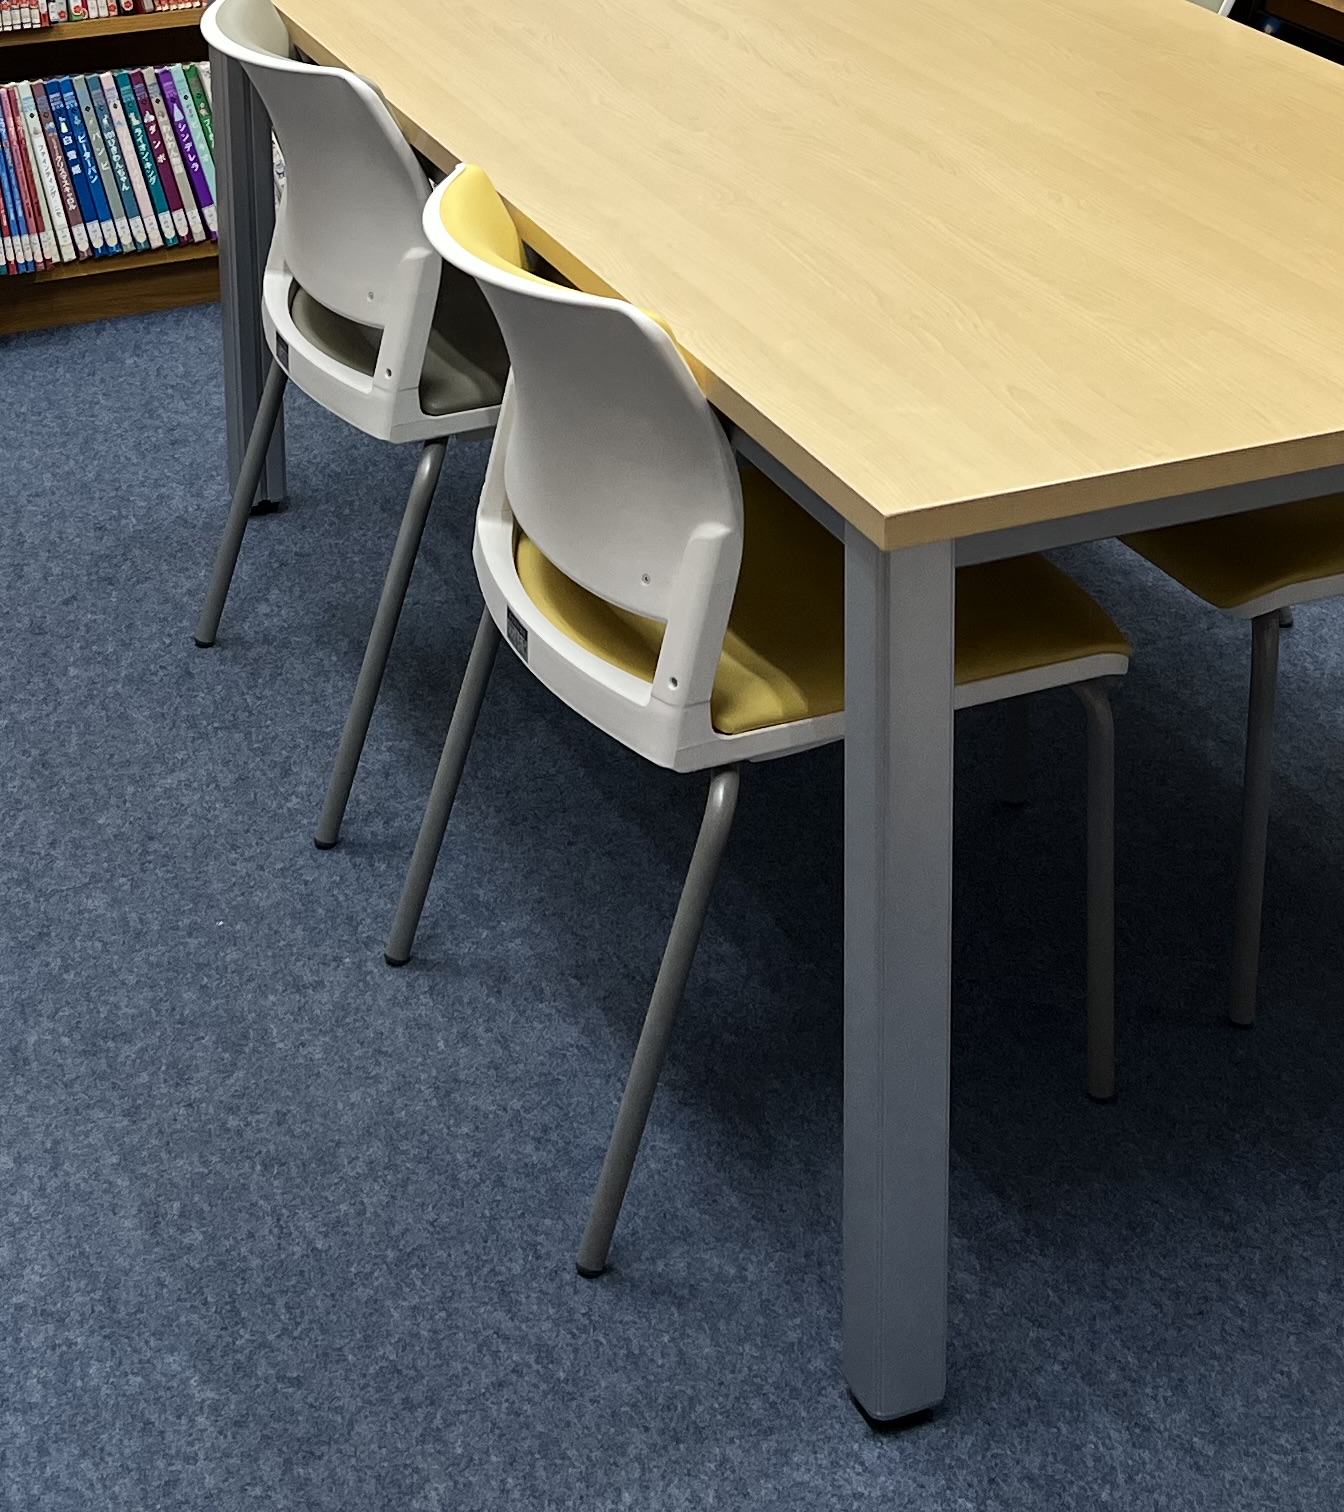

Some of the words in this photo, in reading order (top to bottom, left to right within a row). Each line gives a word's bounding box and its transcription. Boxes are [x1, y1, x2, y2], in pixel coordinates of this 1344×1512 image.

[148, 125, 167, 164] ダンボ
[178, 122, 200, 172] シンデレラ
